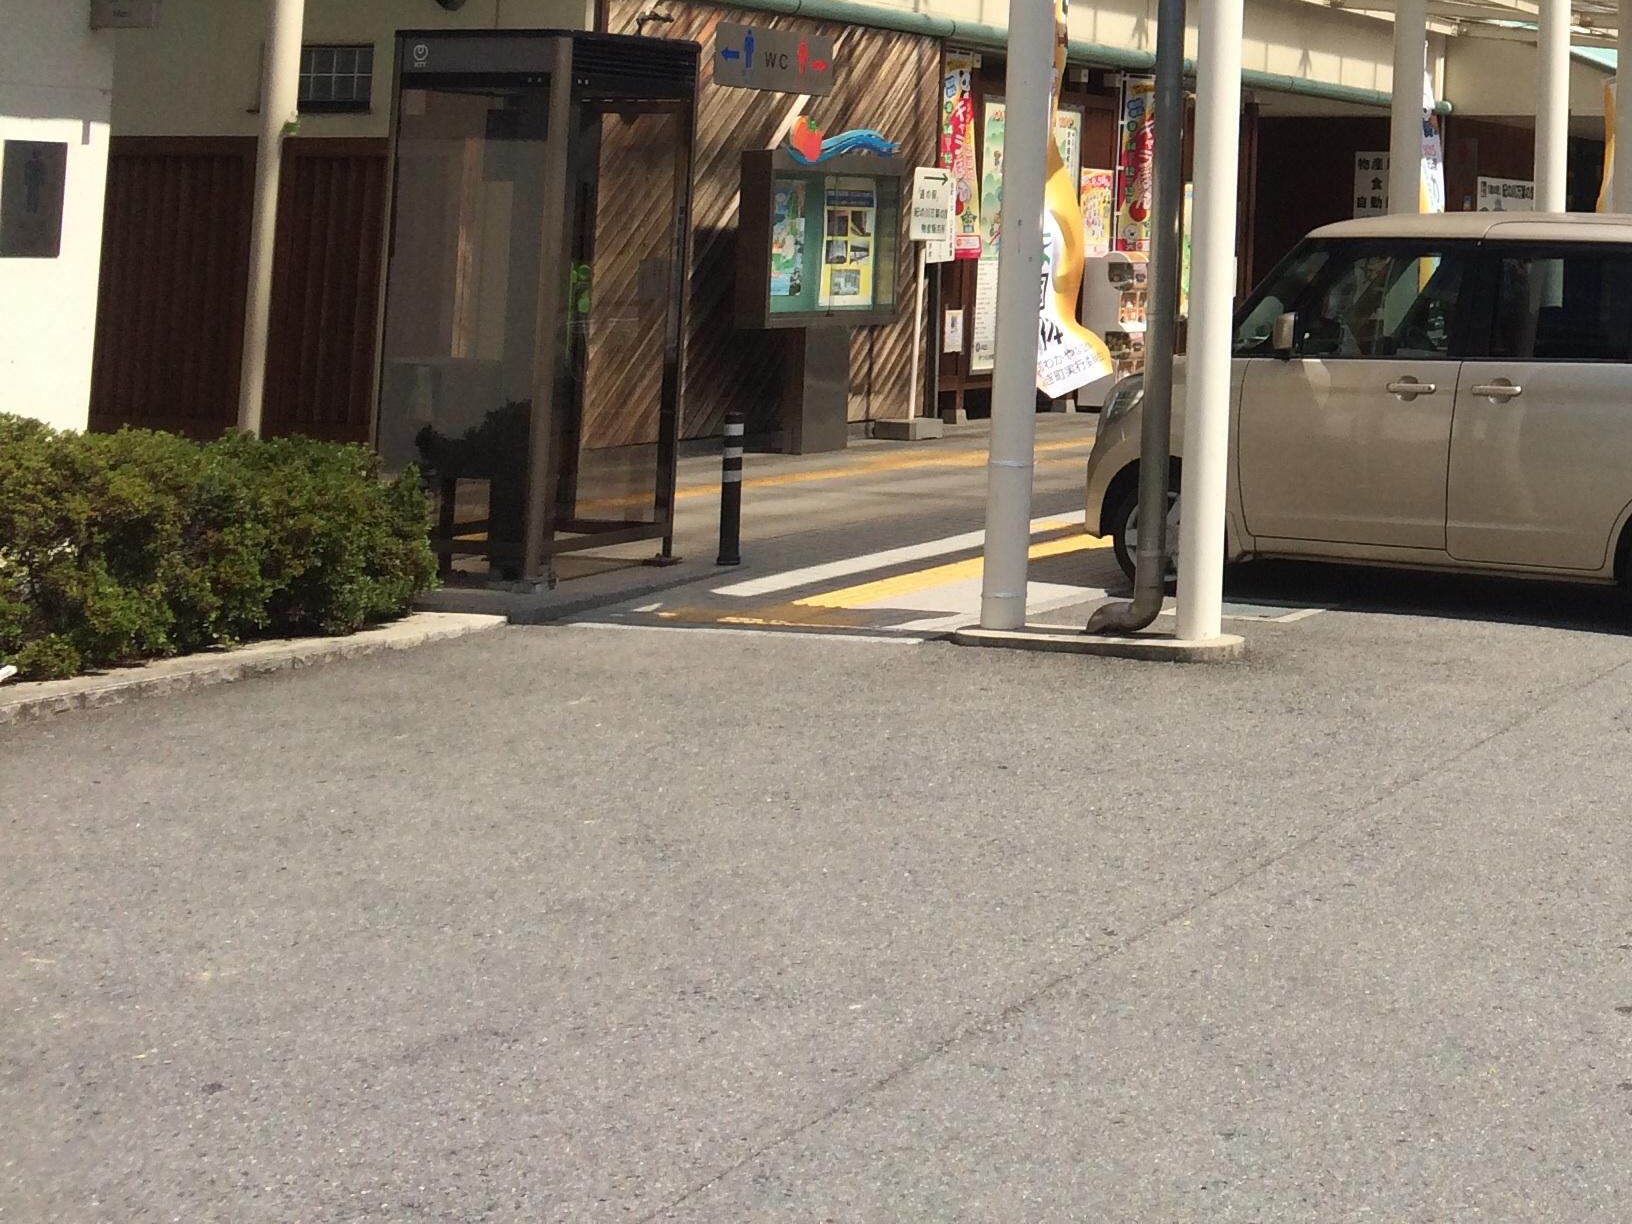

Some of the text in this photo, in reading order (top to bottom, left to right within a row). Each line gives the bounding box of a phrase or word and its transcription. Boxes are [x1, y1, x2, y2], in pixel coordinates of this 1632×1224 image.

[764, 51, 788, 69] WC
[1357, 157, 1390, 171] 物産
[1357, 196, 1389, 209] 自動
